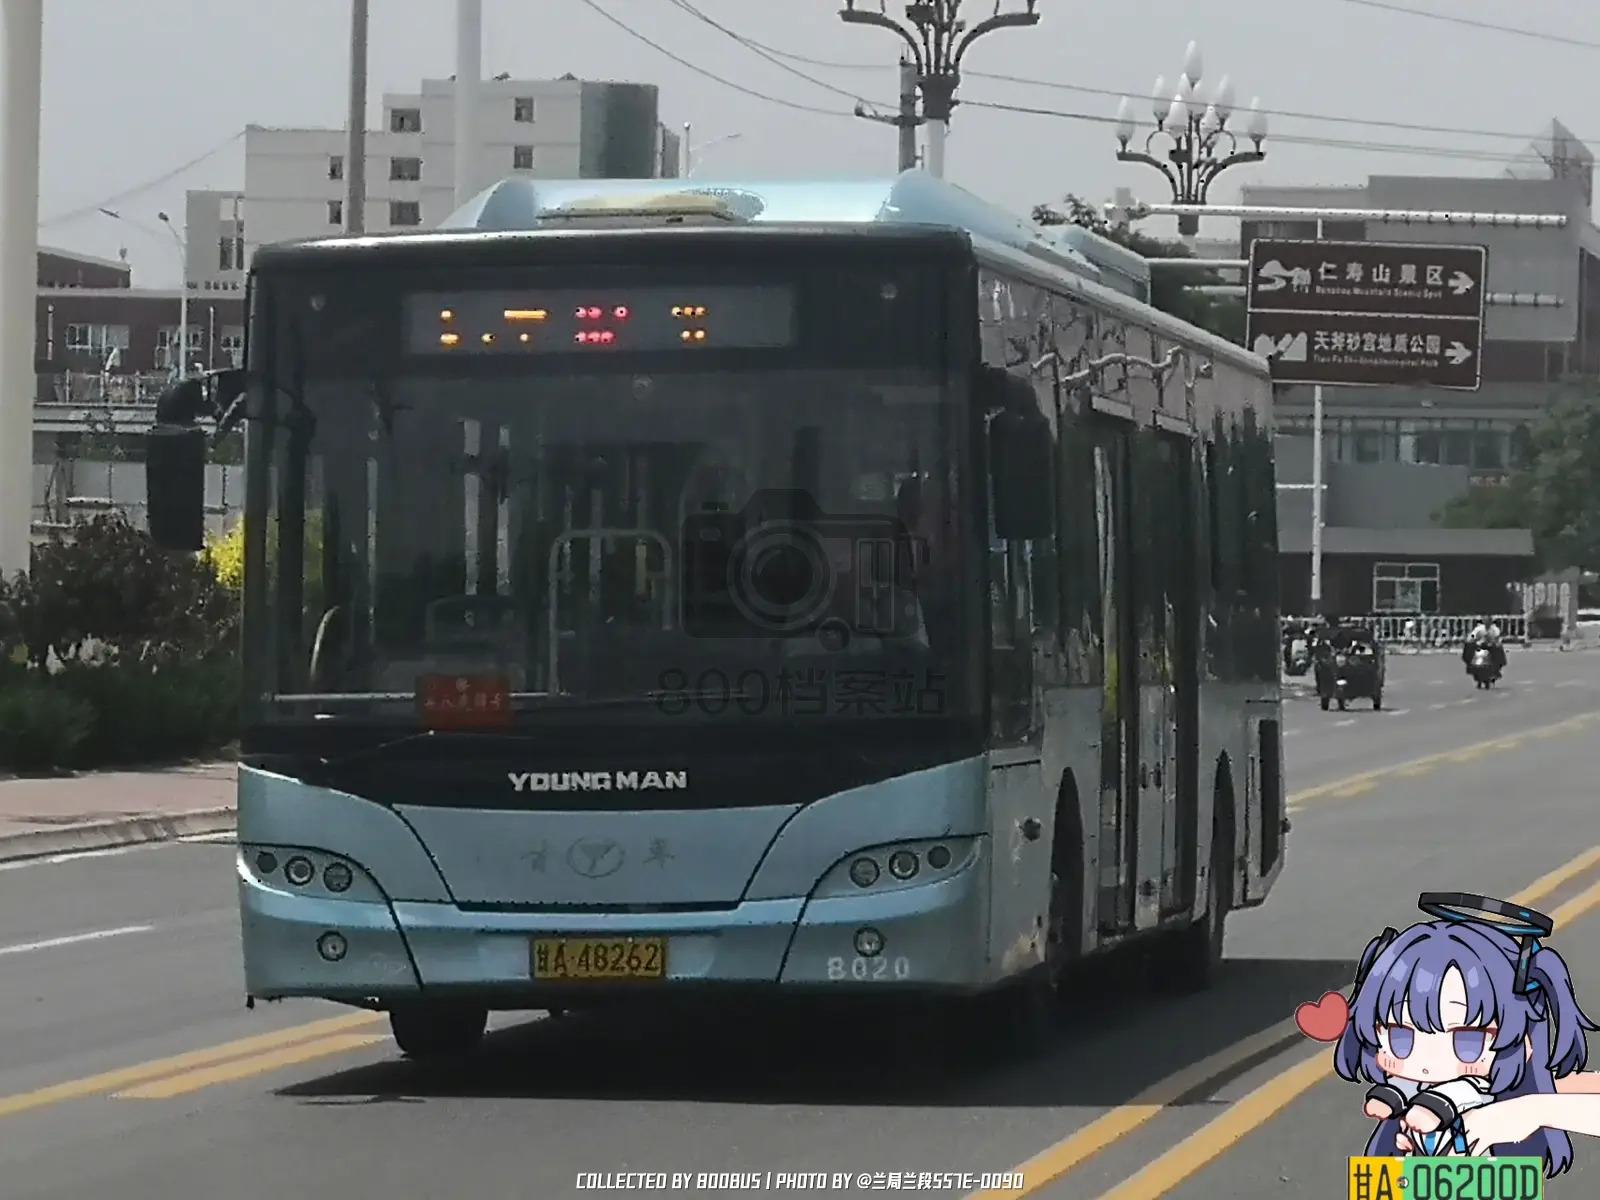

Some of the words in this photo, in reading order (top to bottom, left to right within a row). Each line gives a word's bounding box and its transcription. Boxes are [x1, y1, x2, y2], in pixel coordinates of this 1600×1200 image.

[1318, 261, 1444, 286] 仁寿山景区
[1422, 288, 1443, 300] Spot
